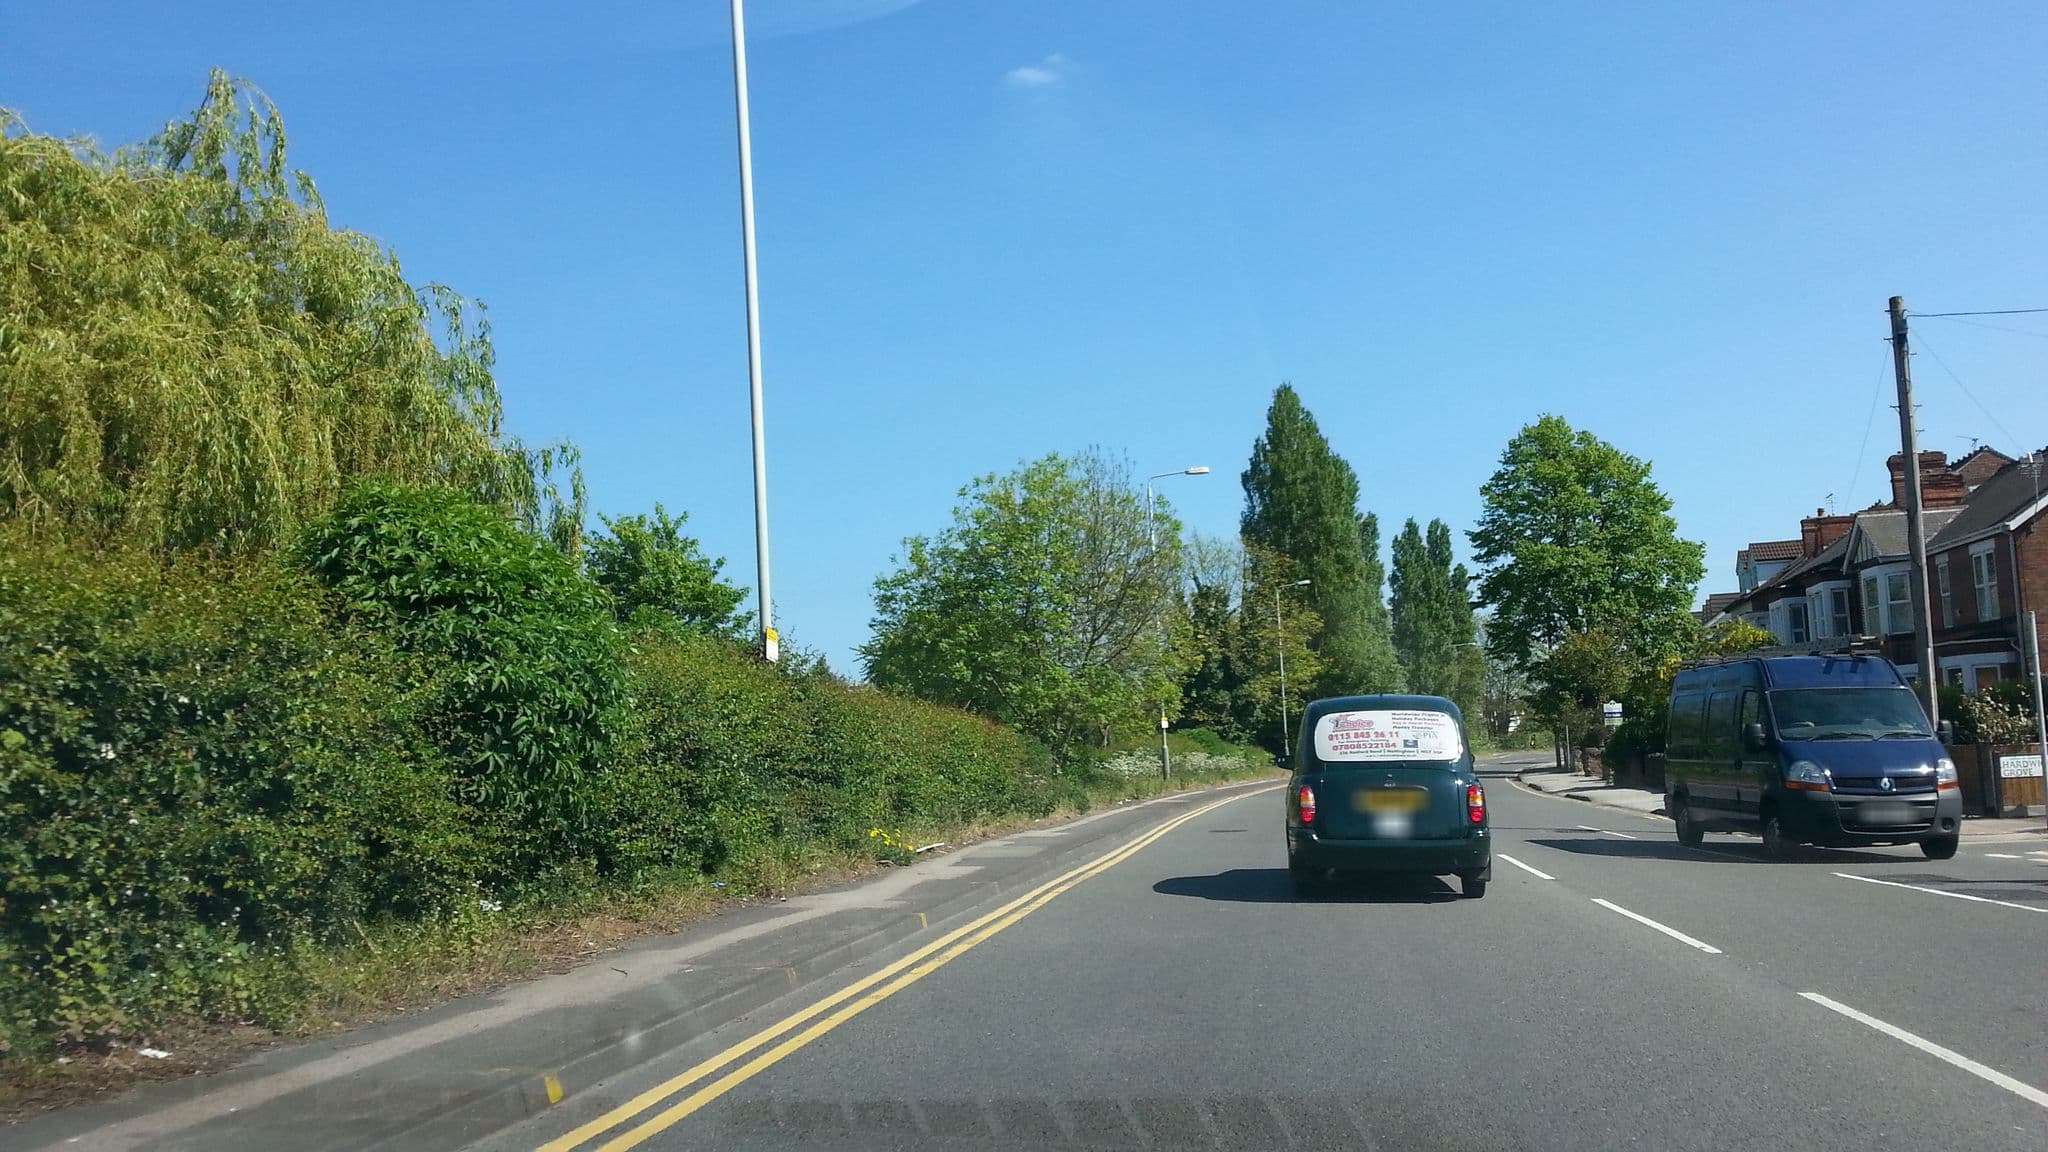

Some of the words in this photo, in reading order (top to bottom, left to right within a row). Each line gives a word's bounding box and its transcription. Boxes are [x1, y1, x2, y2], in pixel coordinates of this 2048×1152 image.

[1328, 733, 1350, 741] 0115
[2002, 760, 2041, 768] HARDWI
[2003, 768, 2033, 776] GROVE
